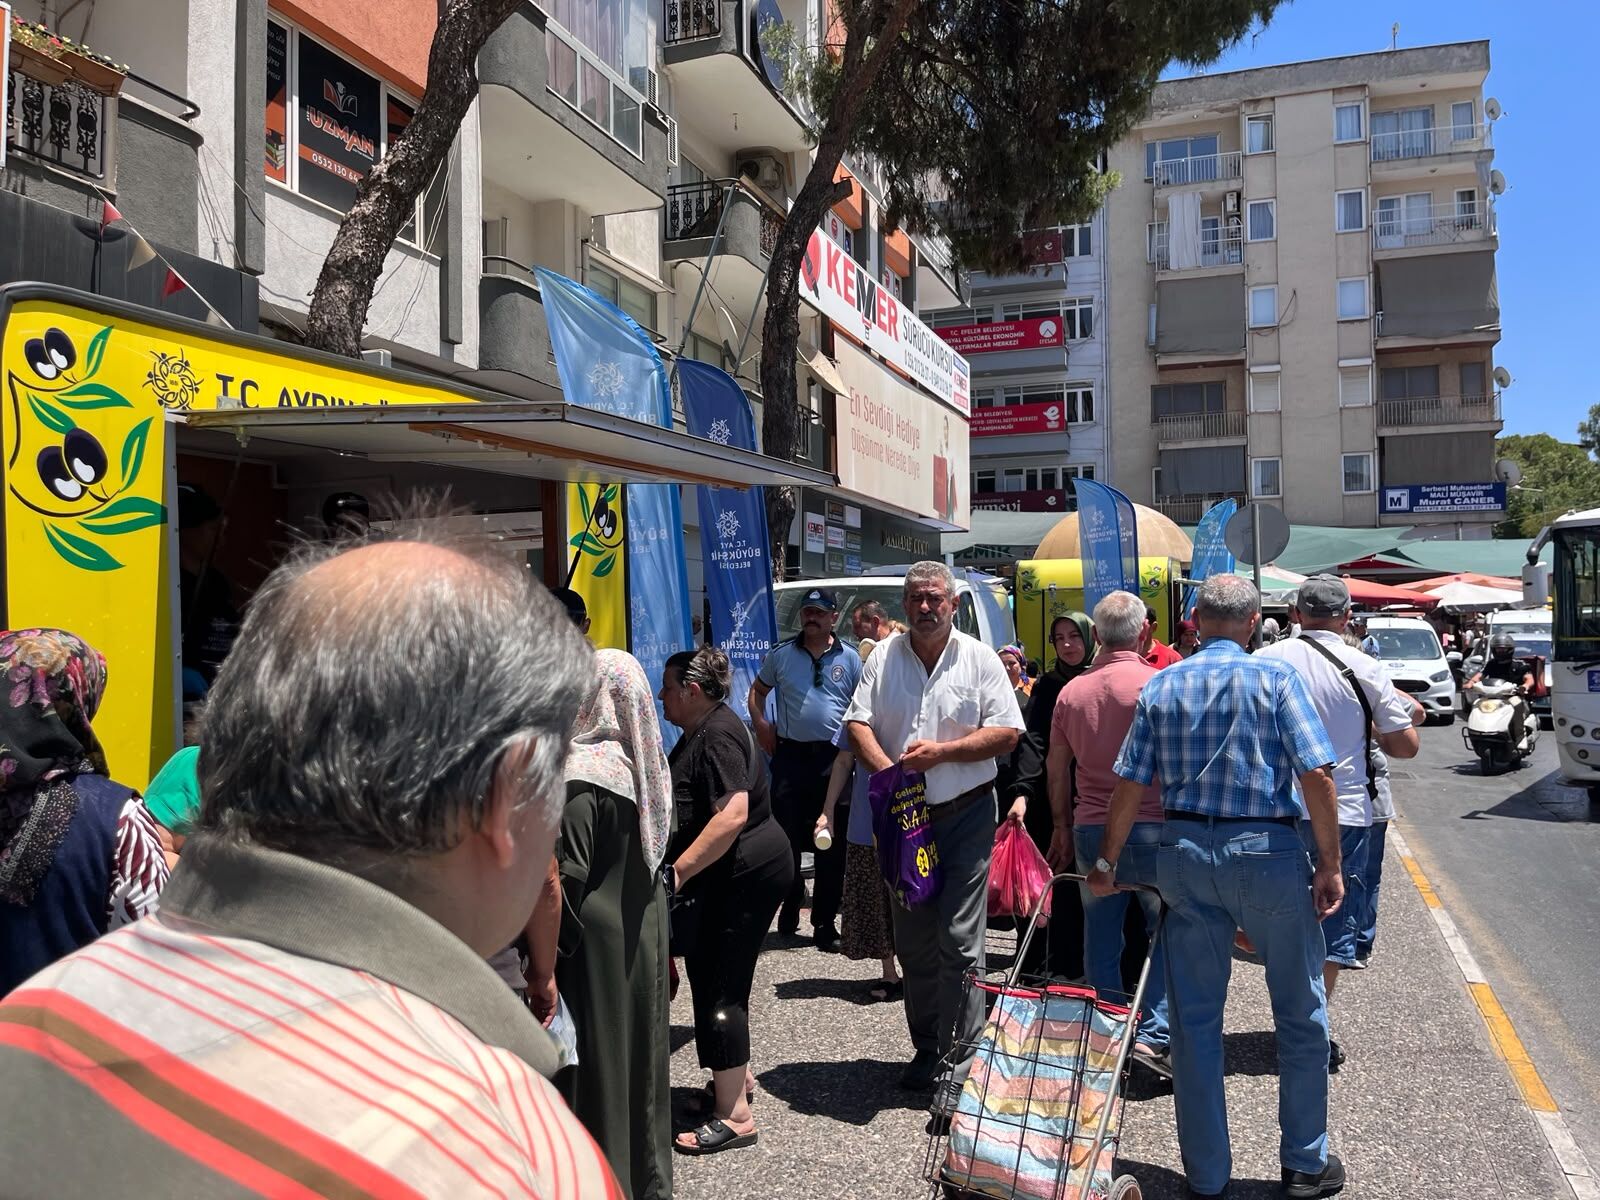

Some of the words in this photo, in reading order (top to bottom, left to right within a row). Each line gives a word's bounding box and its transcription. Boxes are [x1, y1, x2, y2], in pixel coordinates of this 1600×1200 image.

[310, 106, 375, 158] UZMAN
[312, 153, 333, 170] 0532
[334, 163, 347, 177] 130
[826, 239, 899, 342] KEMER
[903, 314, 930, 359] SÜRÜCÜ
[930, 338, 953, 377] KURSU
[849, 386, 861, 418] En
[863, 394, 894, 438] Sevdiği
[896, 412, 920, 451] Hediye
[851, 427, 884, 462] Düşünme
[885, 444, 907, 473] Nerede
[908, 455, 920, 480] Diye
[1419, 498, 1451, 506] Murat
[1454, 496, 1495, 505] CANER
[1449, 484, 1493, 492] Muhasebeci
[1449, 490, 1484, 498] MÜŞAVİR
